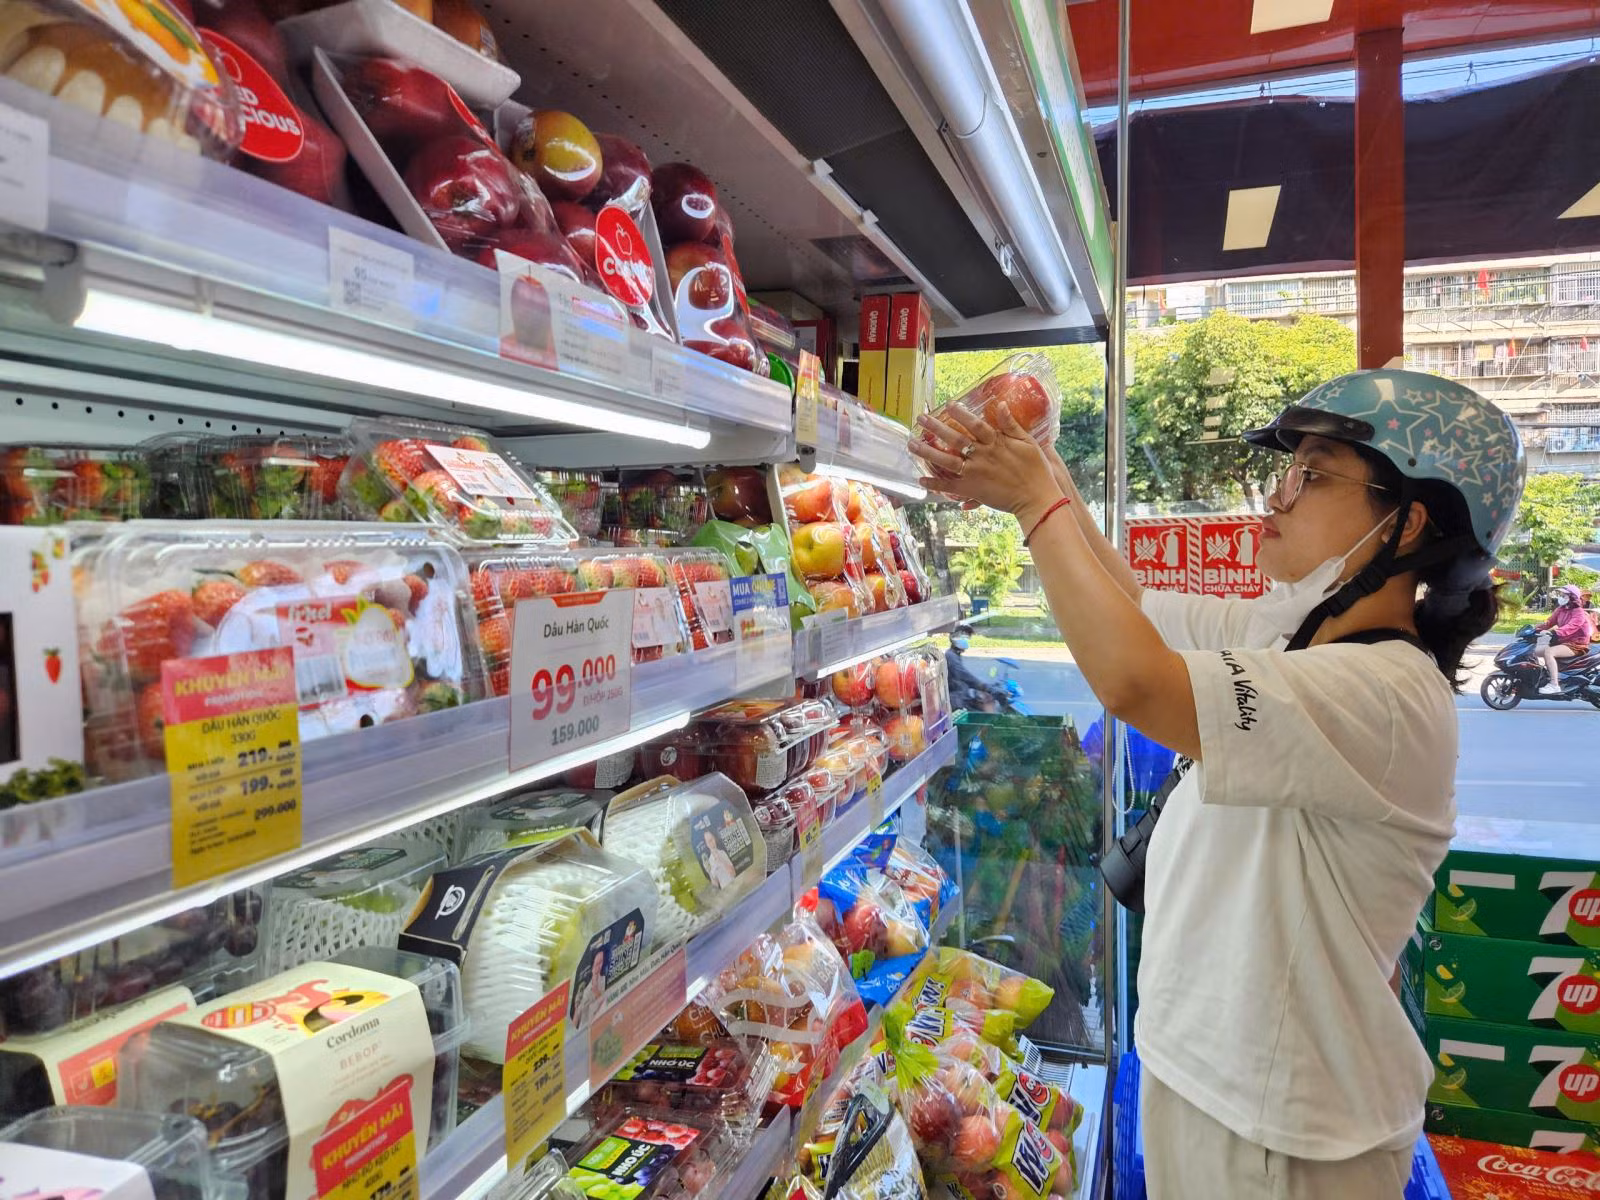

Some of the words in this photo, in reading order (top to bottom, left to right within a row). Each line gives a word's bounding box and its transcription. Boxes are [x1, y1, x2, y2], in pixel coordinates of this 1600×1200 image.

[1203, 564, 1261, 585] BÌNH
[732, 581, 750, 597] MUA
[1203, 584, 1232, 593] CHỮA
[1233, 584, 1261, 593] CHÁY
[543, 621, 564, 639] Dâu
[566, 618, 585, 635] Hàn
[587, 614, 609, 631] Quốc
[1233, 680, 1259, 731] Vitality
[551, 715, 600, 746] 159.000
[326, 1015, 381, 1049] Cordoma
